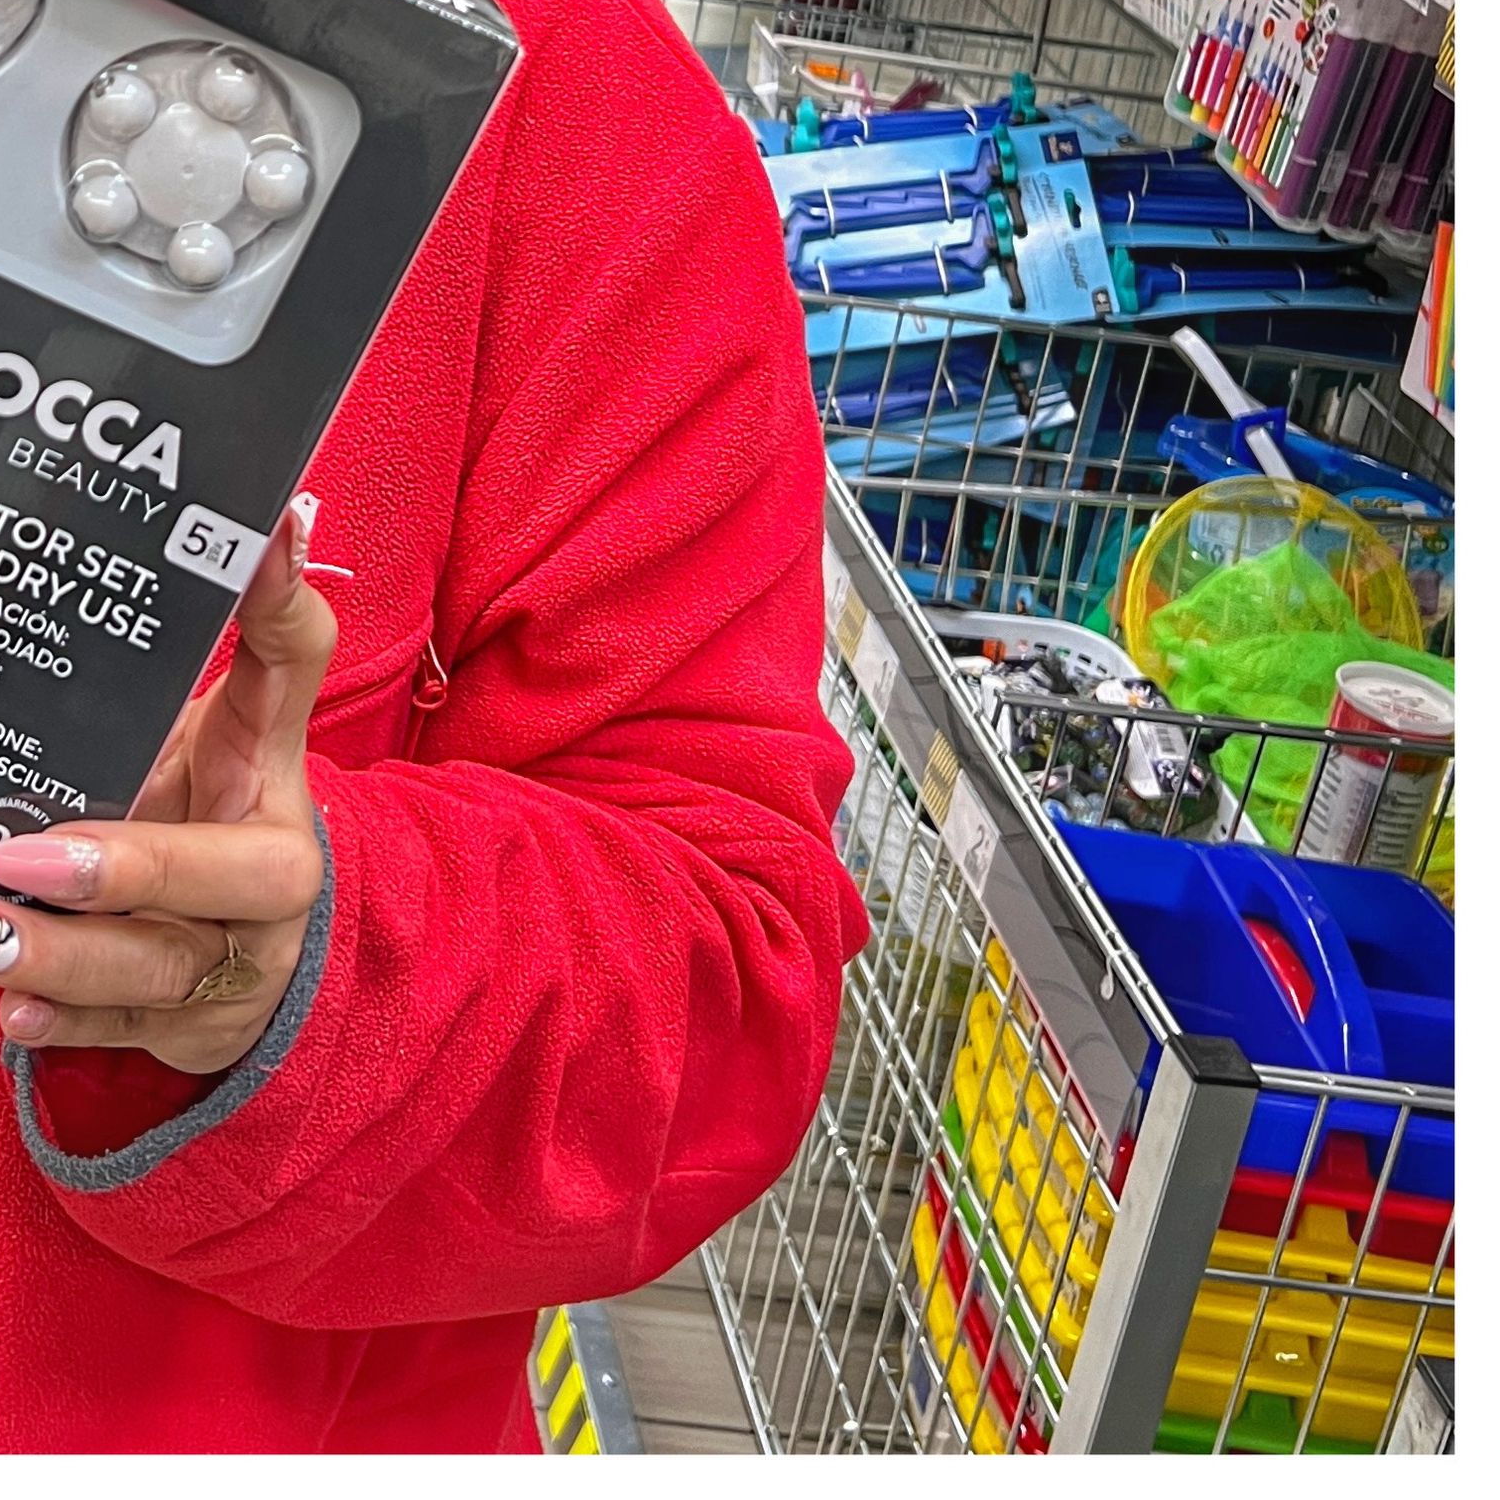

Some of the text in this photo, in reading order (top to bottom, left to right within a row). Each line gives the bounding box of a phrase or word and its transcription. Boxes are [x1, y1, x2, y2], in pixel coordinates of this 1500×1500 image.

[7, 437, 167, 523] BEAUTY
[77, 545, 159, 605] SET:
[78, 588, 162, 650] USE
